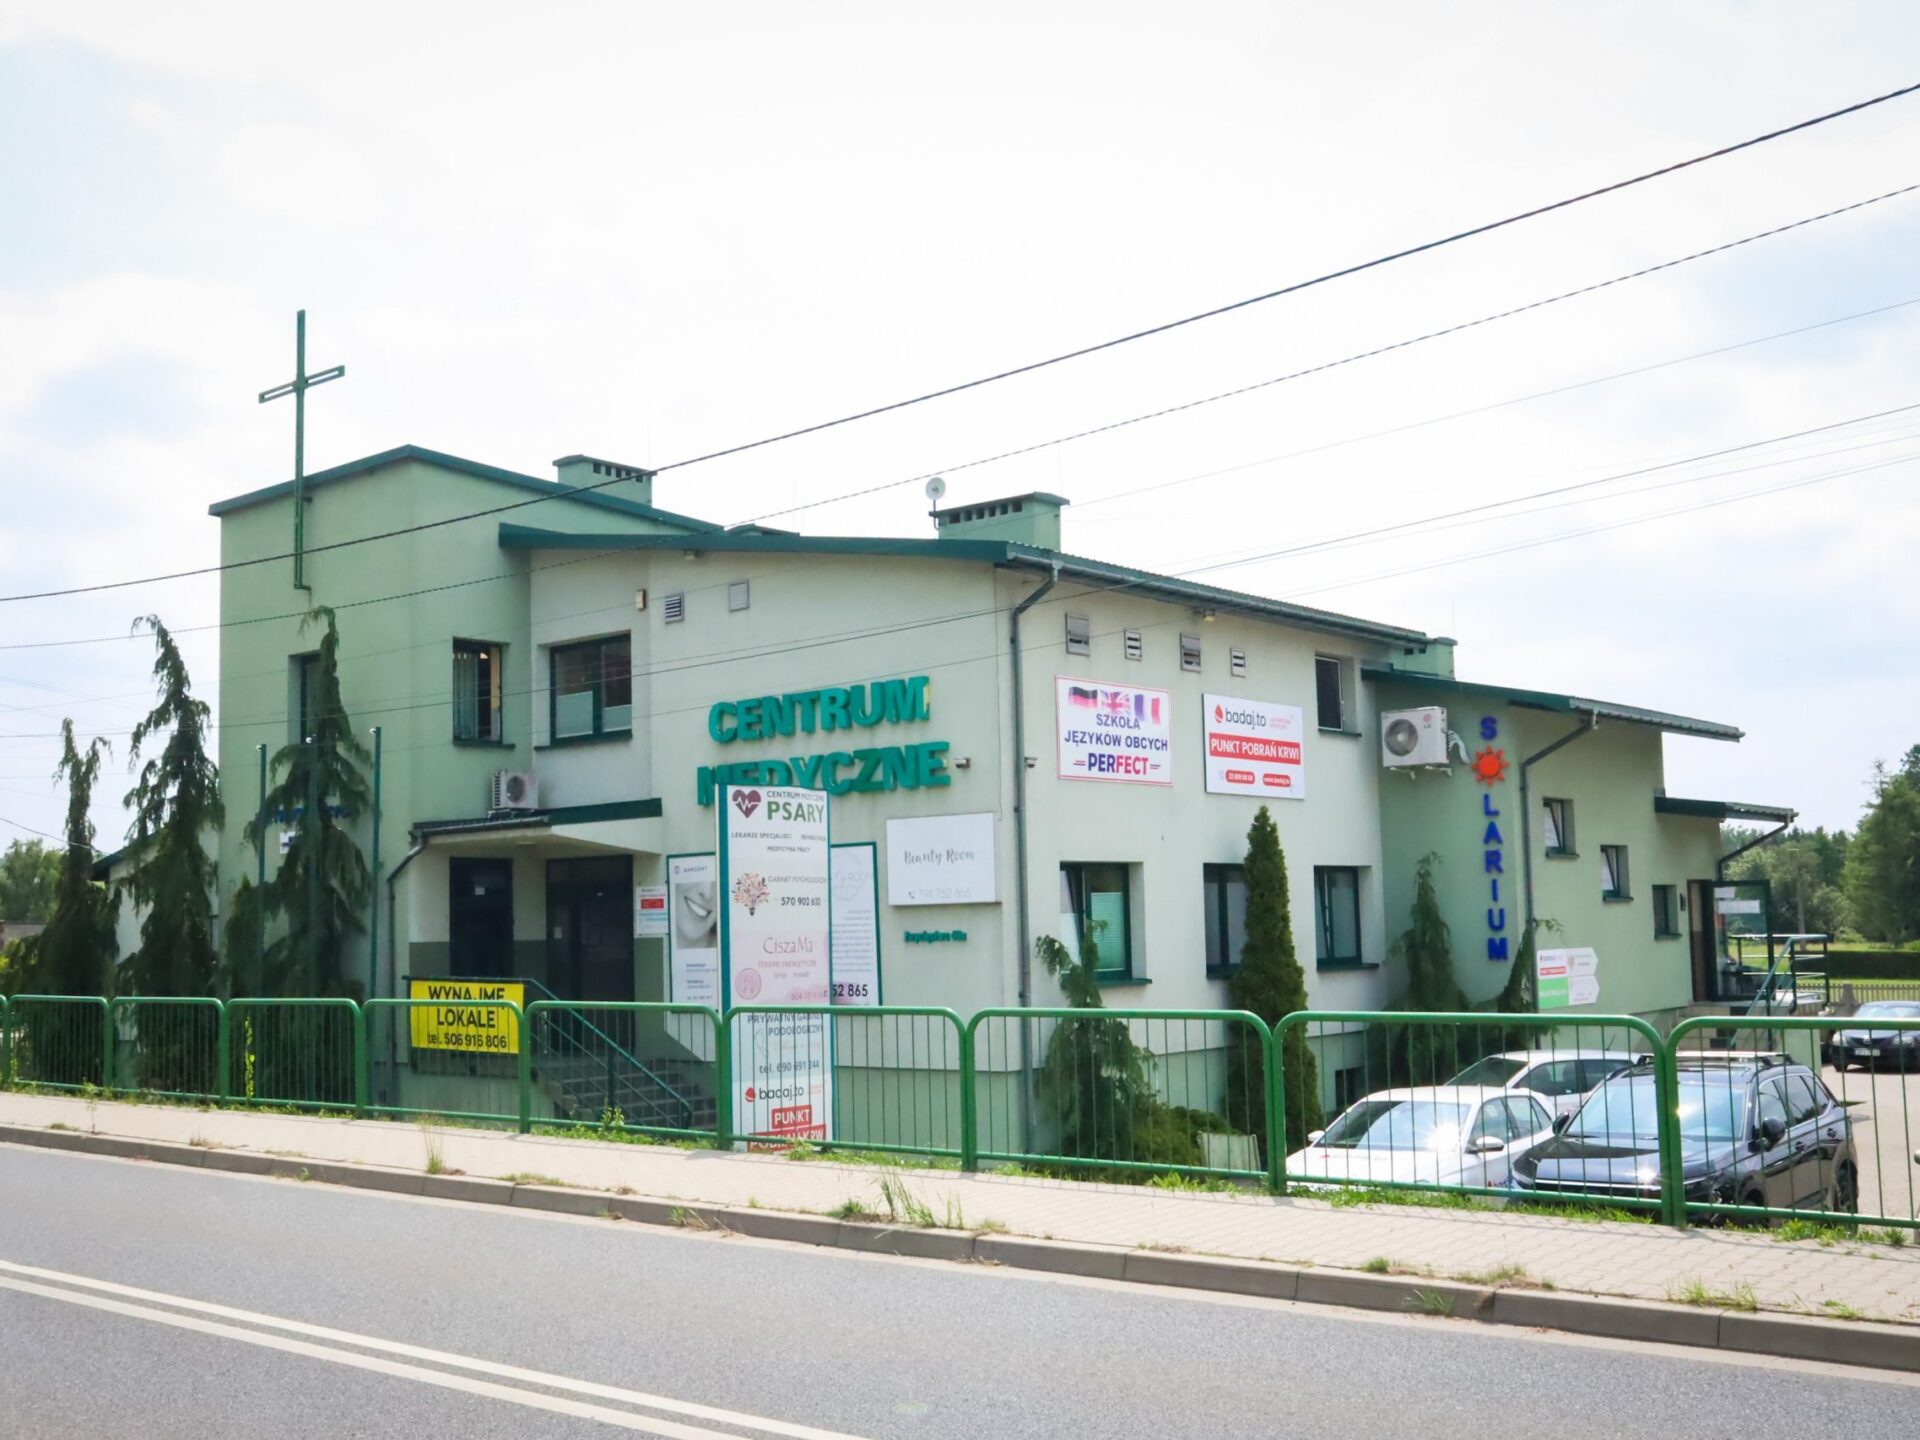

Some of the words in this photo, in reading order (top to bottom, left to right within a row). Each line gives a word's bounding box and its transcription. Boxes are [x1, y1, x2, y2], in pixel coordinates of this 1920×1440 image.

[708, 675, 931, 745] CENTRUM
[1225, 707, 1267, 730] badaj.to
[1096, 713, 1141, 730] SZKOŁA
[1064, 730, 1122, 747] JĘZYKÓW
[1124, 735, 1168, 752] OBCYCH
[1211, 738, 1241, 754] PUNKT
[1242, 741, 1277, 758] POBRAŃ
[1277, 745, 1299, 760] KRWI
[1088, 753, 1149, 775] PERFECT
[697, 741, 951, 807] MEDYCZNE
[766, 790, 800, 799] CENTRUM
[767, 801, 824, 824] PSARY
[946, 848, 975, 864] Room
[781, 897, 796, 906] 570
[798, 897, 810, 906] 902
[848, 984, 869, 997] 865
[437, 1008, 496, 1029] LOKALE
[444, 1032, 463, 1046] 506
[465, 1034, 483, 1047] 916
[485, 1035, 507, 1049] 806
[759, 1063, 775, 1074] tel.
[774, 1108, 810, 1126] PUNKT
